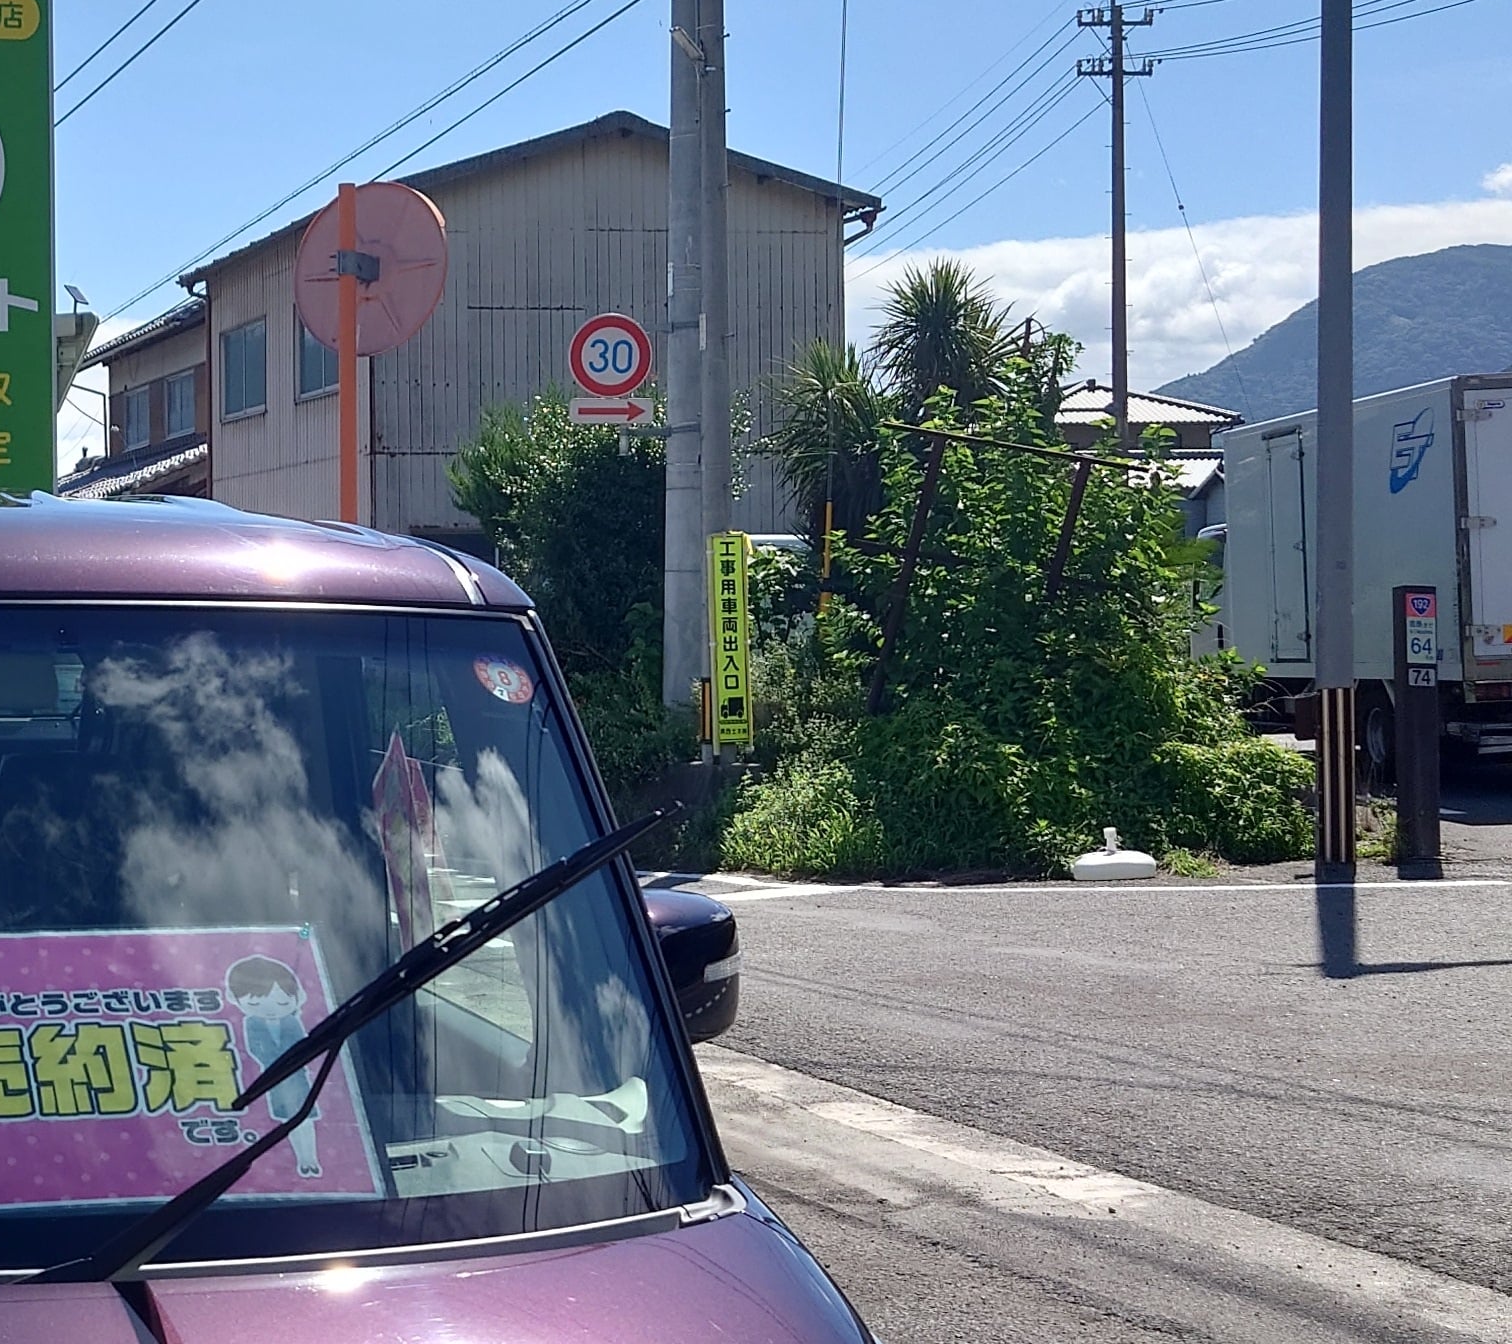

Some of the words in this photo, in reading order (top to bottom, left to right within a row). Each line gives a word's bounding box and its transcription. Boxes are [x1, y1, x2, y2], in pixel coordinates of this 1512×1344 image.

[589, 339, 633, 374] 30
[719, 541, 740, 690] 工事用車両出入口
[1411, 637, 1433, 654] 64
[1412, 670, 1431, 684] 74
[181, 1119, 258, 1144] です。
